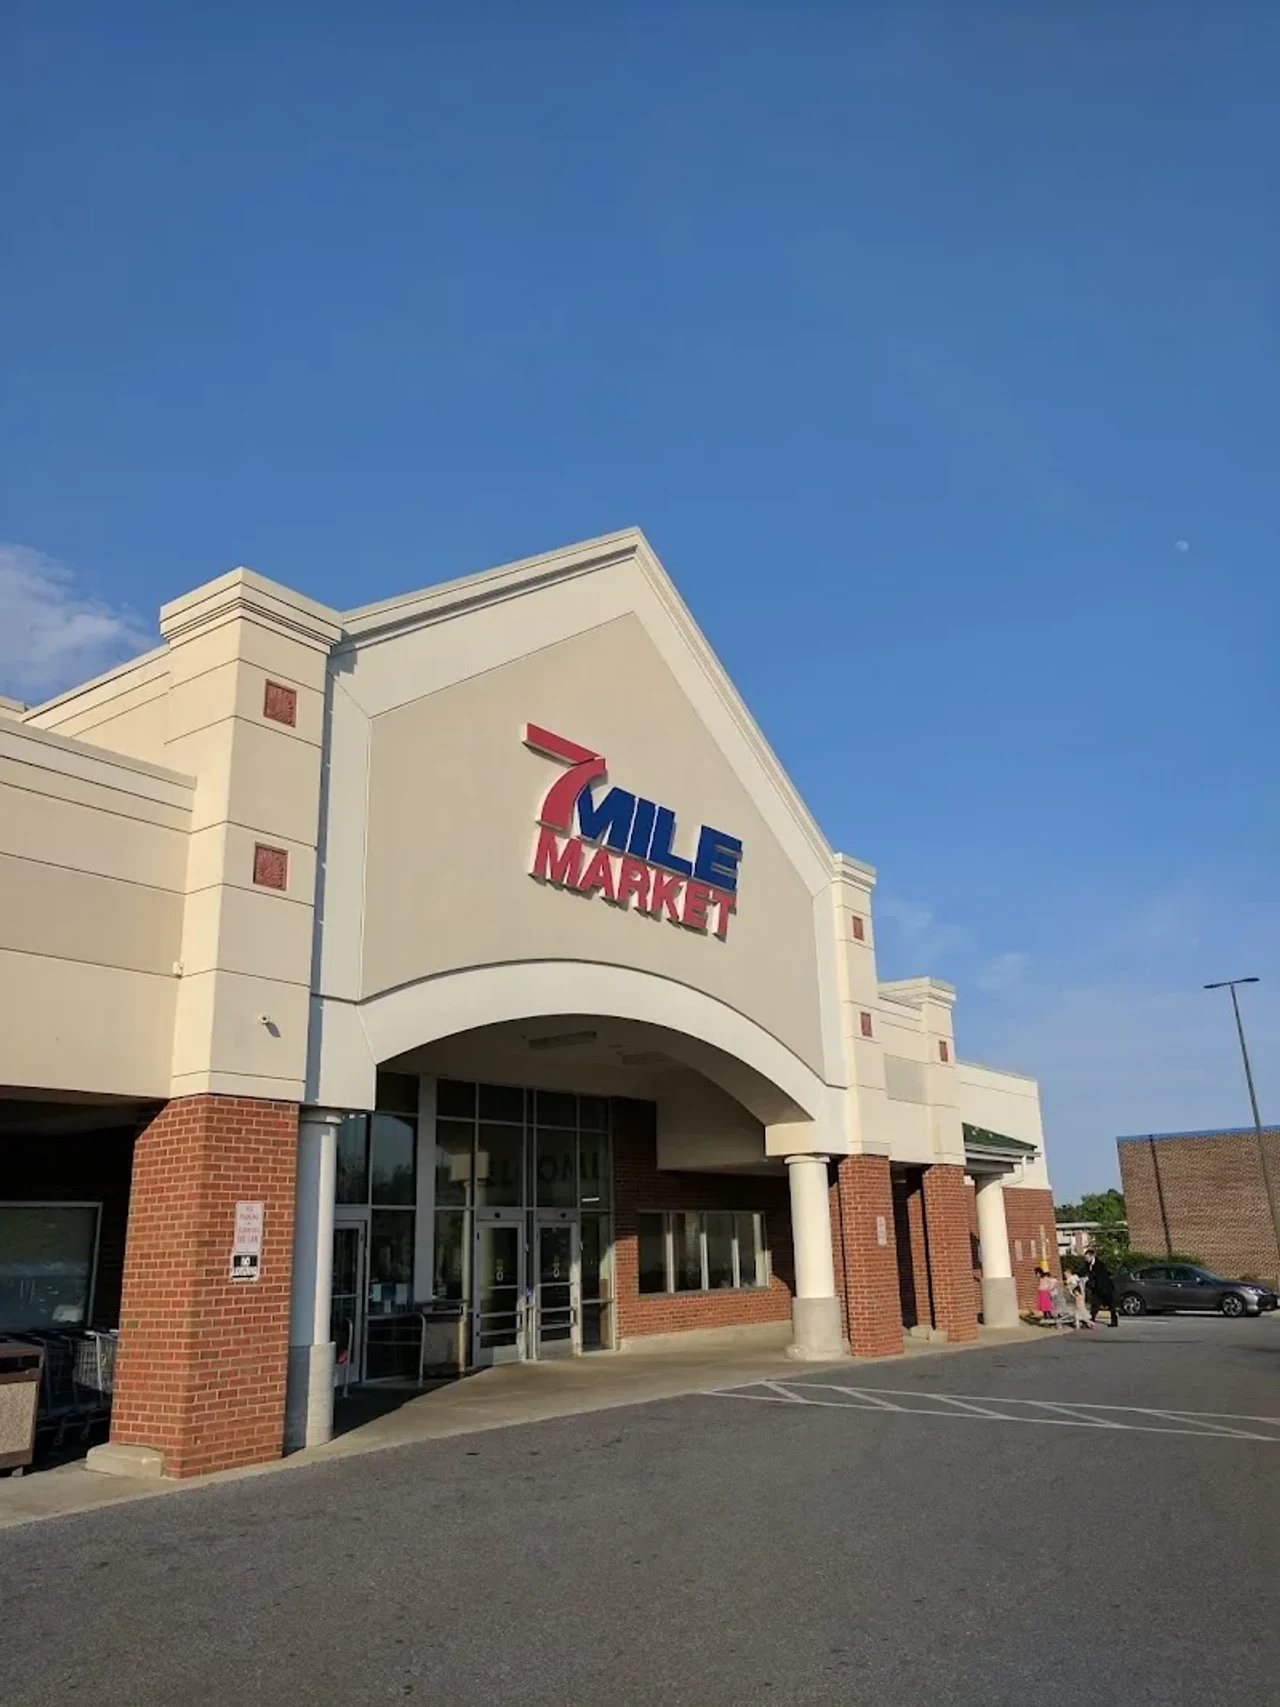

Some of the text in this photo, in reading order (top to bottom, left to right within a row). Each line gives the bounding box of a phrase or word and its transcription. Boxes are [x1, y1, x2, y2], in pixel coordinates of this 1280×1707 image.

[523, 722, 743, 893] 7 MILE
[531, 829, 737, 940] MARKET
